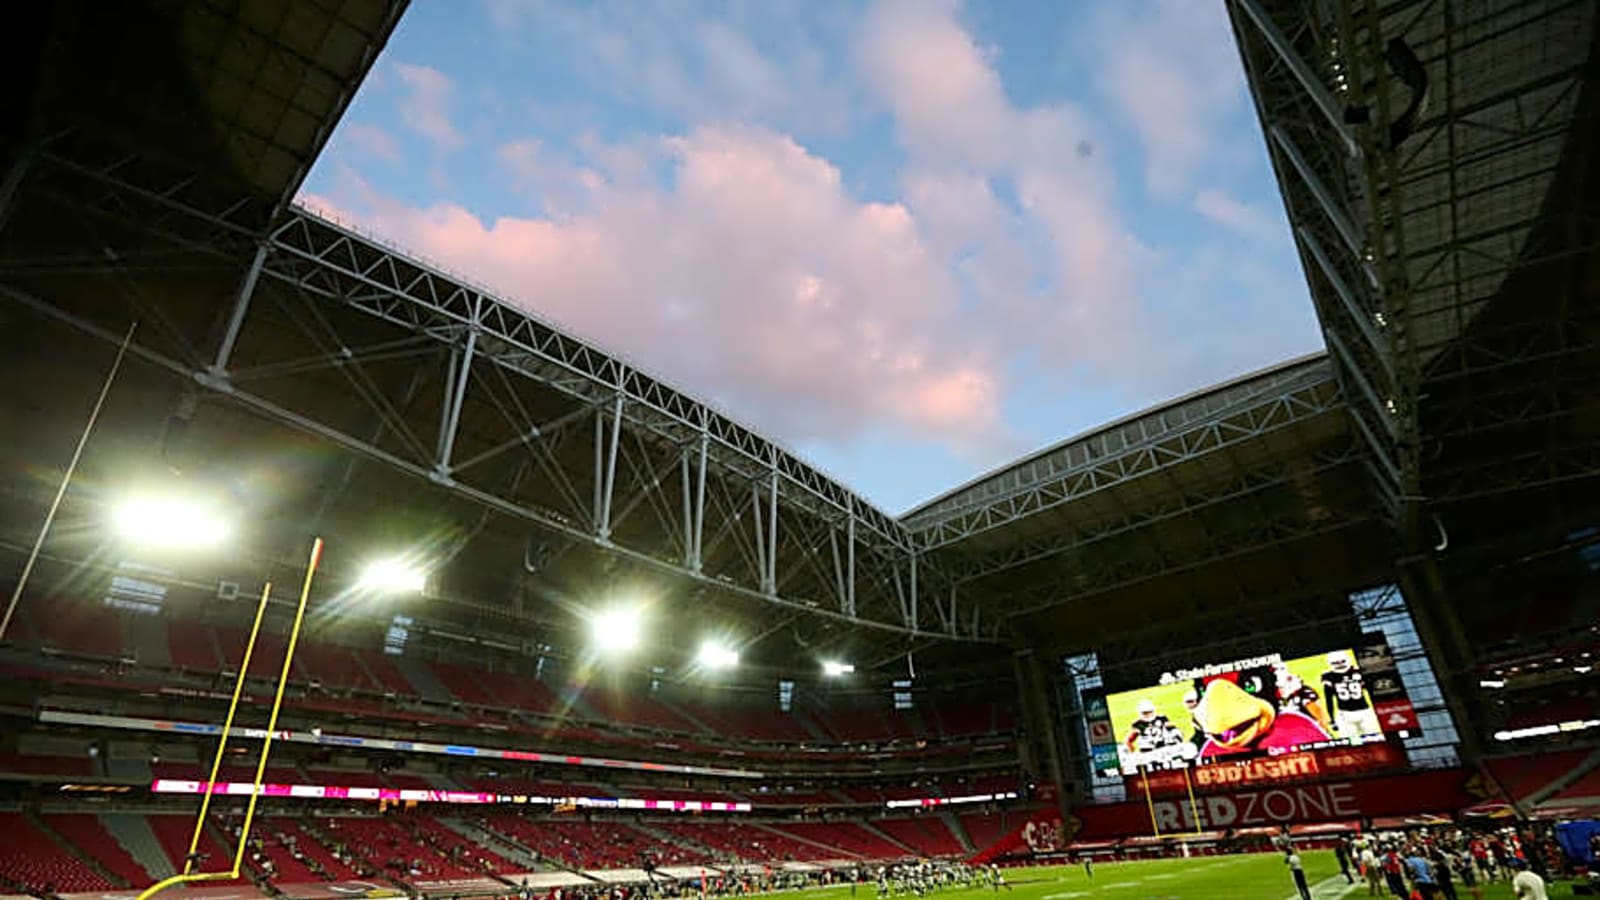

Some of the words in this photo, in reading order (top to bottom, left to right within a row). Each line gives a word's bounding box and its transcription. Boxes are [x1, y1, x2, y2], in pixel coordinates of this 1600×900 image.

[1175, 666, 1203, 680] State
[1204, 662, 1233, 677] Farm
[1234, 653, 1281, 671] STADIUM
[1335, 682, 1362, 701] 59
[1195, 766, 1242, 785] BUD
[1244, 755, 1310, 780] LIGHT
[1153, 783, 1361, 831] REDZONE
